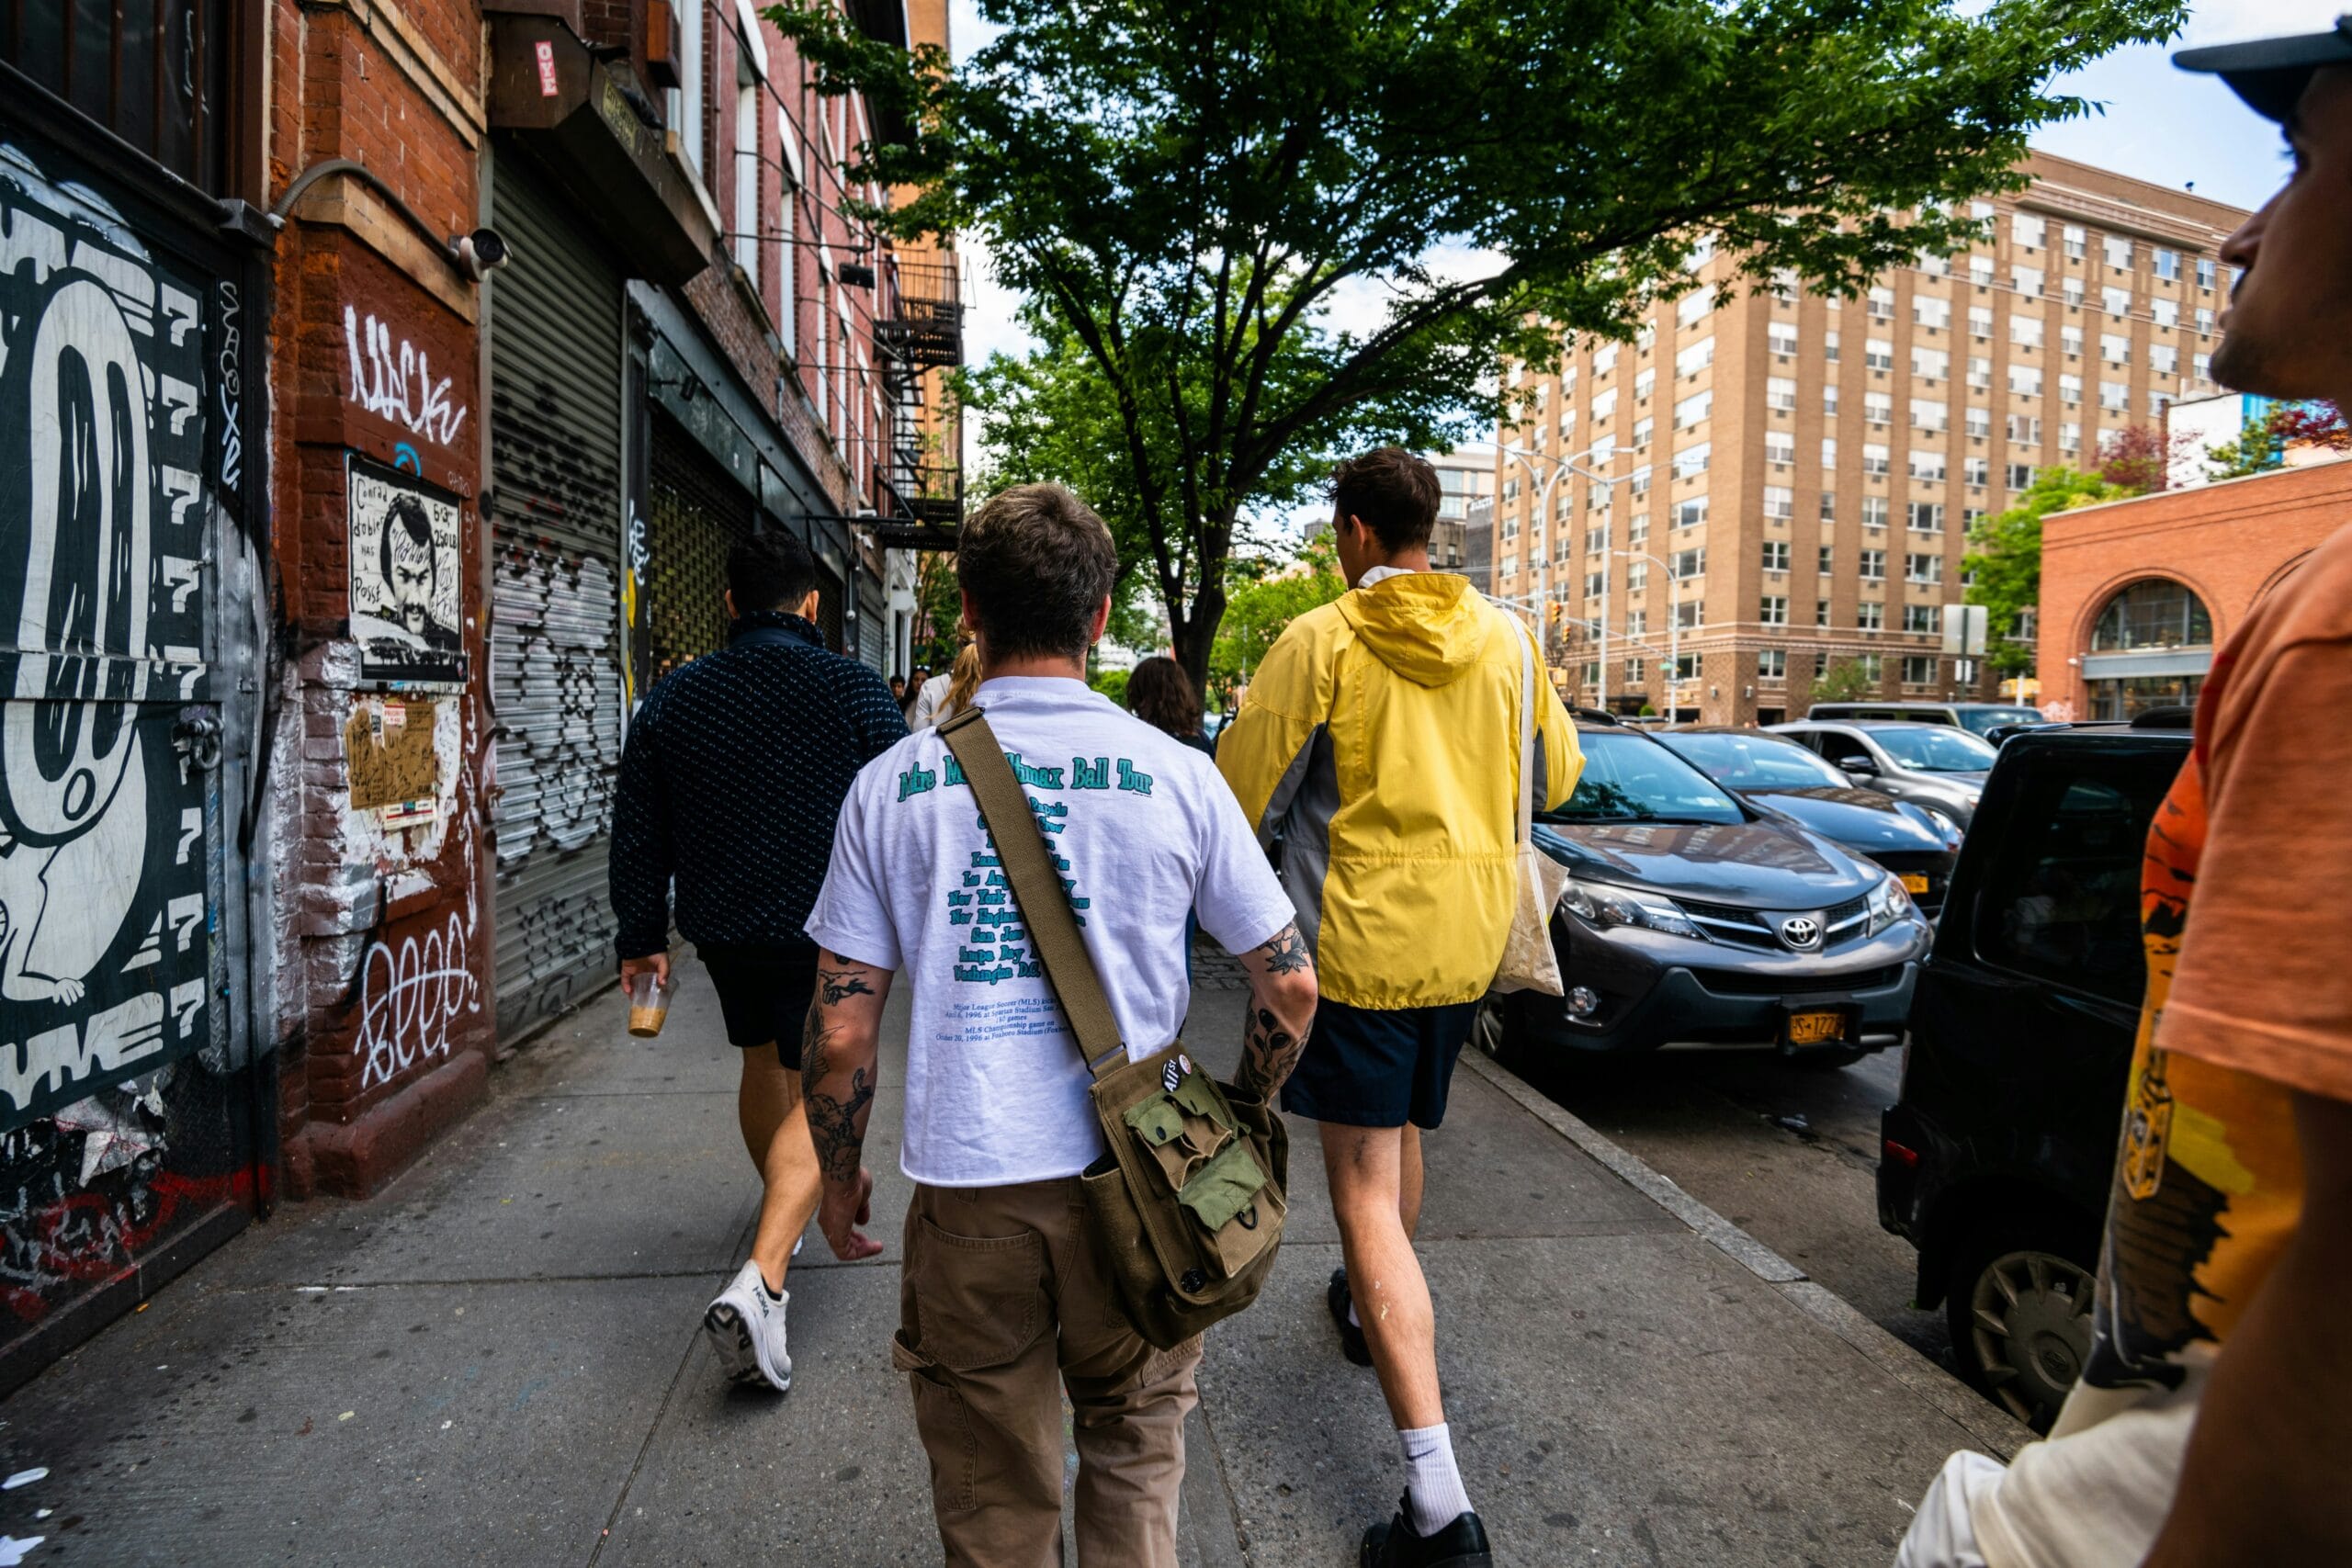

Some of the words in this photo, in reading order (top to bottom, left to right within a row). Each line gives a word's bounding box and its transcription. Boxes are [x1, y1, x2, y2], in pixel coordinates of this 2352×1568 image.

[537, 43, 557, 95] OYE
[1070, 757, 1110, 790] Ball
[1117, 758, 1154, 795] Tour
[976, 889, 1006, 905] York
[976, 908, 1022, 928] Englan
[1016, 1028, 1044, 1036] Stadium
[752, 1286, 770, 1319] HOKA
